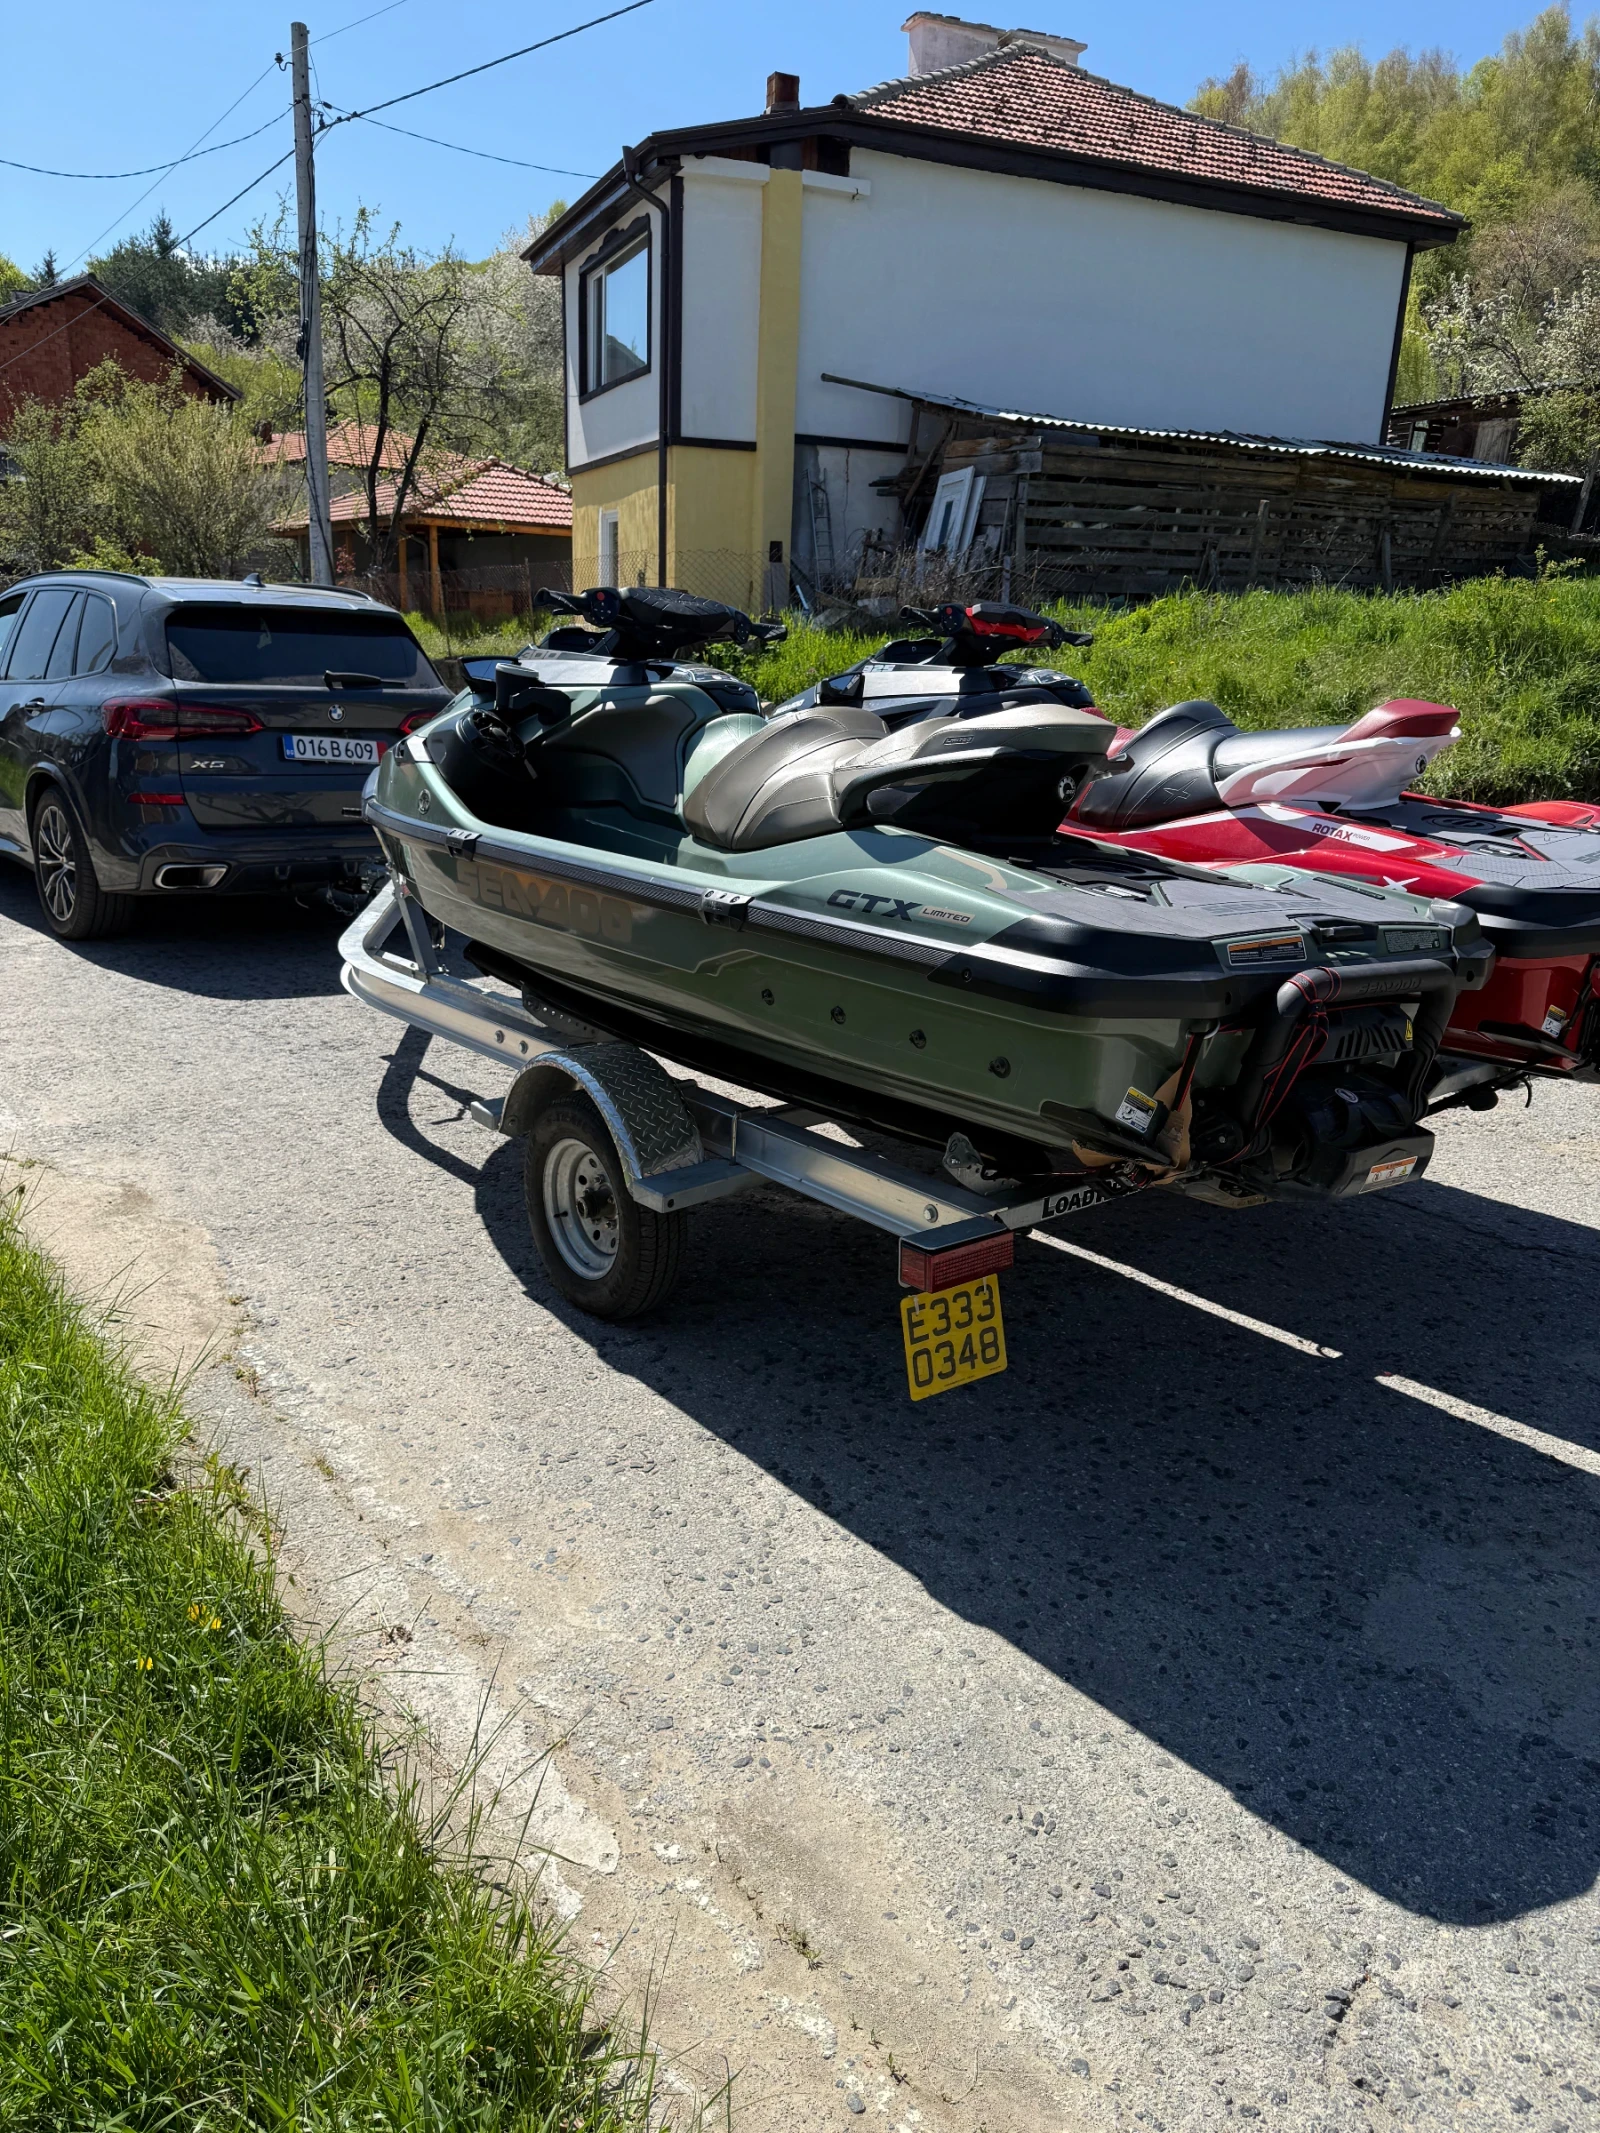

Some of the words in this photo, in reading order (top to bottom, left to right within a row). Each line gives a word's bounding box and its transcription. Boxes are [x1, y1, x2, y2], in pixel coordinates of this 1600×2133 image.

[296, 739, 328, 756] 016
[331, 741, 341, 758] B
[345, 742, 373, 760] 609
[1311, 823, 1354, 842] ROTAX
[826, 889, 923, 922] GTX
[922, 908, 970, 922] LIMITED
[906, 1283, 996, 1346] E333
[912, 1326, 1000, 1388] 0348
